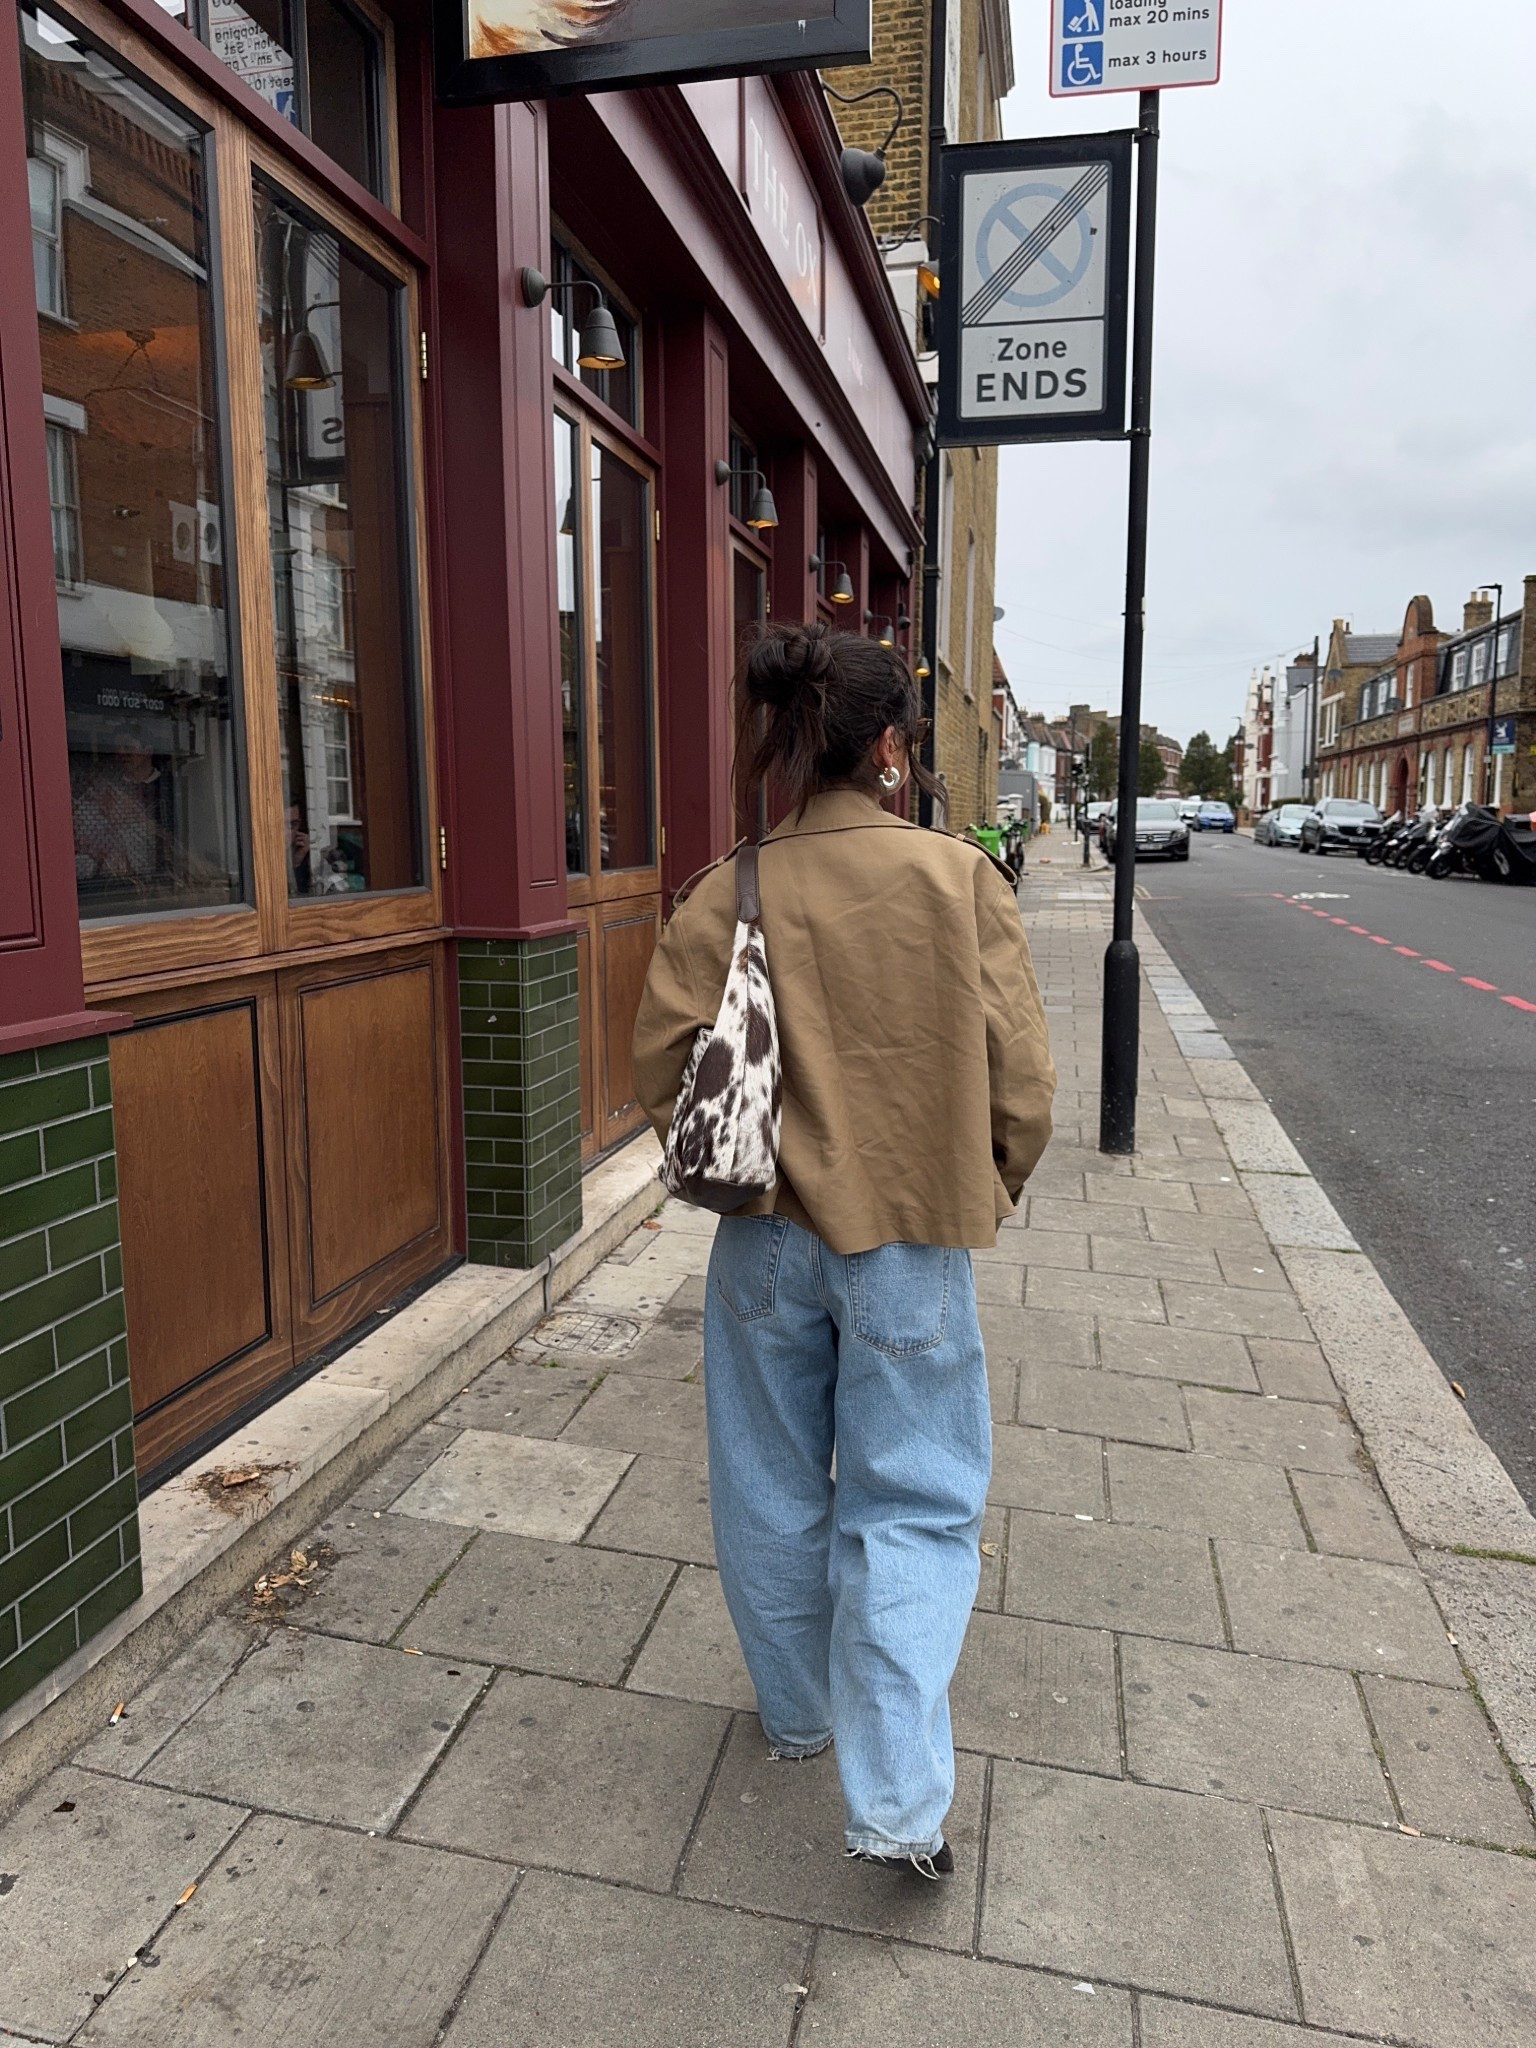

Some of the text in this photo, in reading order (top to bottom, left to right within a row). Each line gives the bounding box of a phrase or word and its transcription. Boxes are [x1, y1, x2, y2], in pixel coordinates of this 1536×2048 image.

[1109, 7, 1210, 27] max 20 mins
[1108, 49, 1207, 68] max 3 hours
[750, 117, 817, 306] THE OX
[997, 337, 1067, 361] Zone
[976, 367, 1087, 403] ENDS
